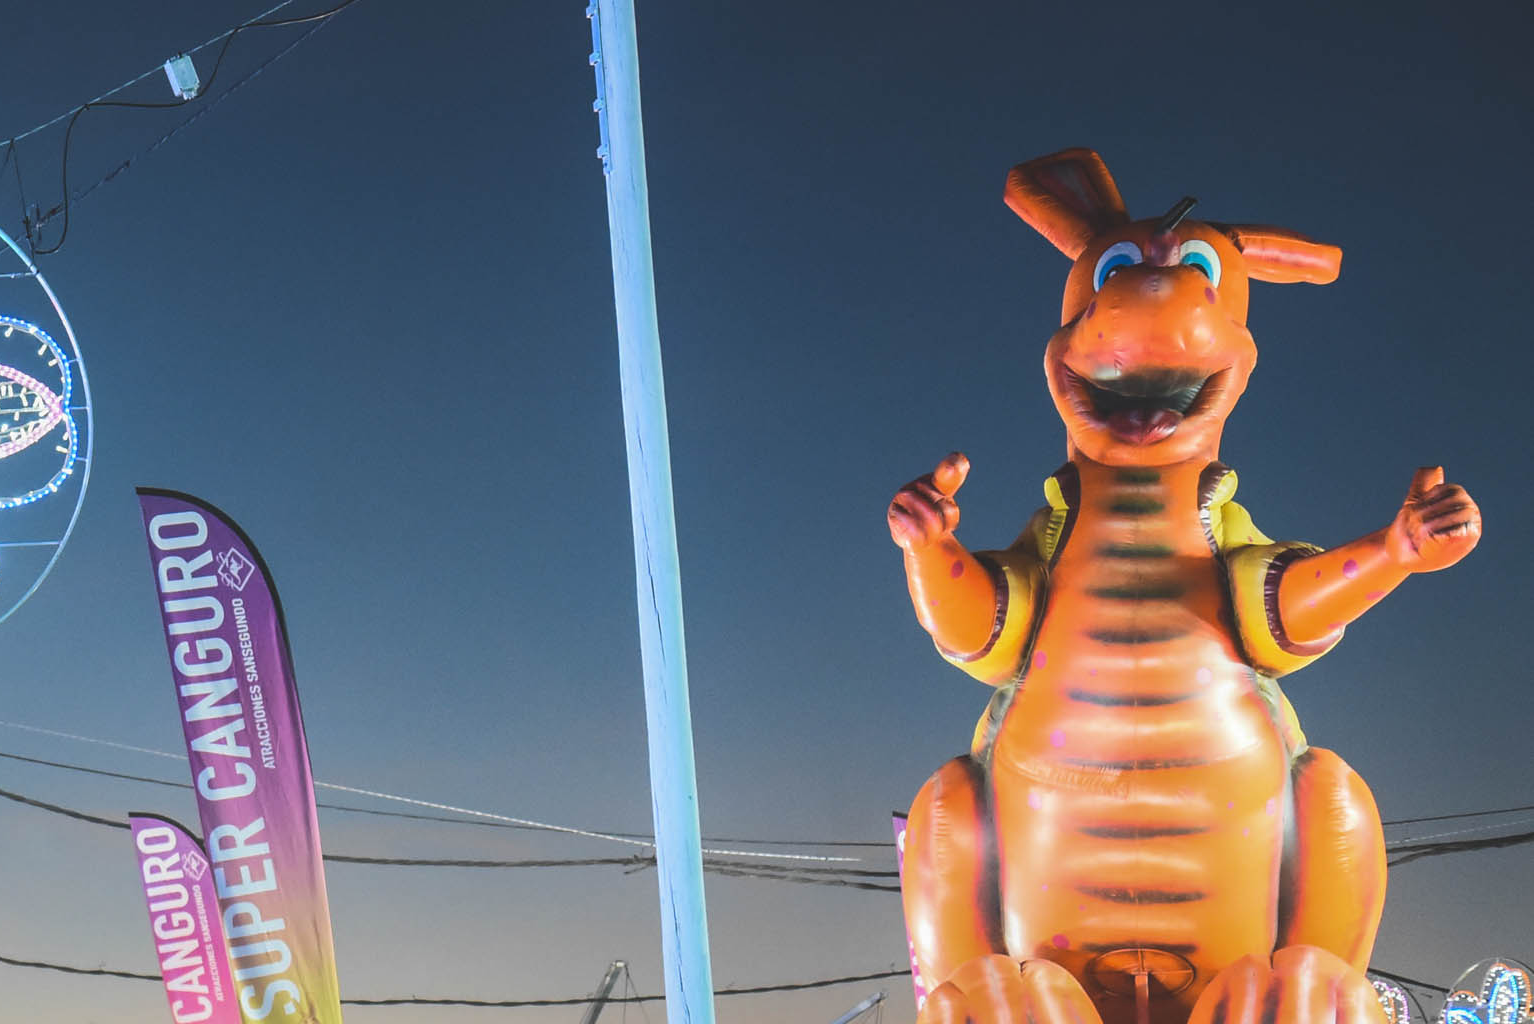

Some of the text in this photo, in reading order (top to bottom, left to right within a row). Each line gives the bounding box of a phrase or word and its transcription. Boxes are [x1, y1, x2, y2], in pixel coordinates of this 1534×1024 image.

[148, 511, 301, 1023] SUPER CANGURO
[232, 598, 276, 769] ATRACCIONES SANSEGUNDO
[135, 825, 214, 1024] CANGURO
[204, 944, 225, 1001] ATRACCIONES
